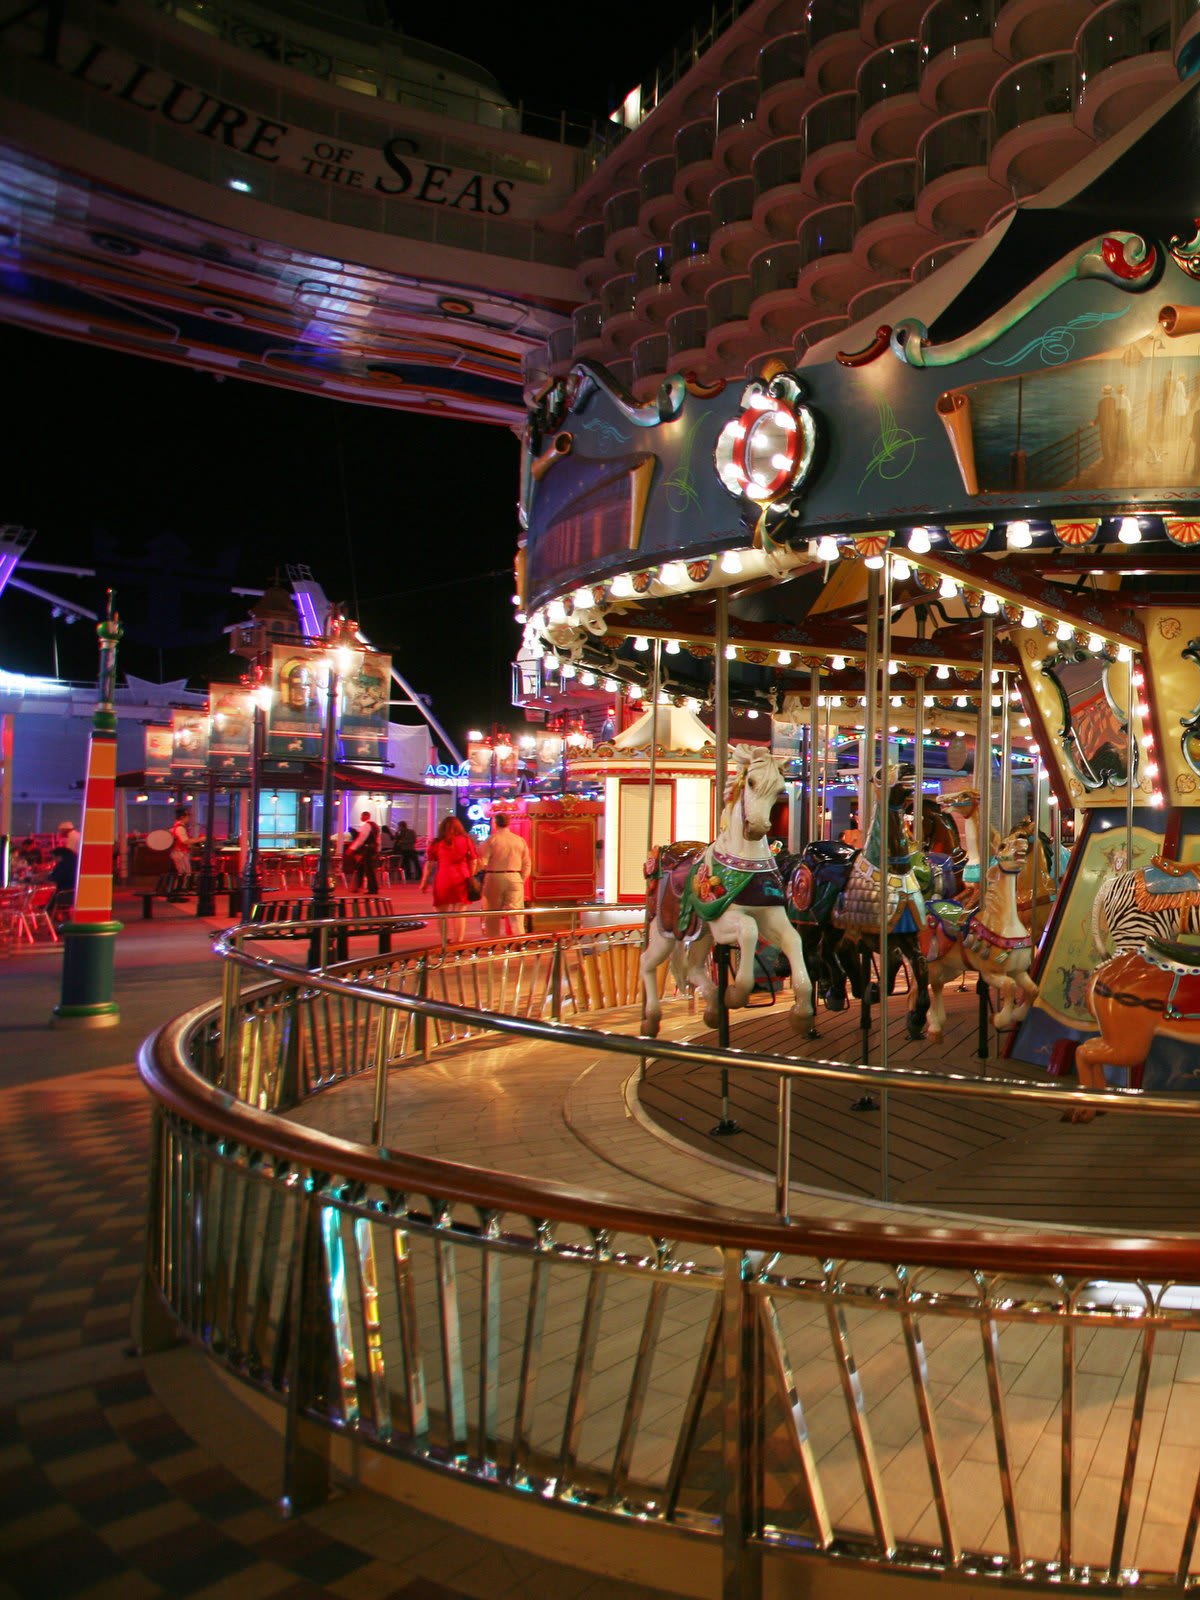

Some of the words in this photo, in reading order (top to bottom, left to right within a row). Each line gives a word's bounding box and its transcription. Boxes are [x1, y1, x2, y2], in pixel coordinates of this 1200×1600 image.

[0, 0, 289, 163] ALLURE
[313, 141, 354, 165] OF
[302, 156, 364, 189] THE
[374, 138, 514, 216] SEAS
[424, 777, 470, 787] THEATER
[425, 764, 470, 779] AQUA
